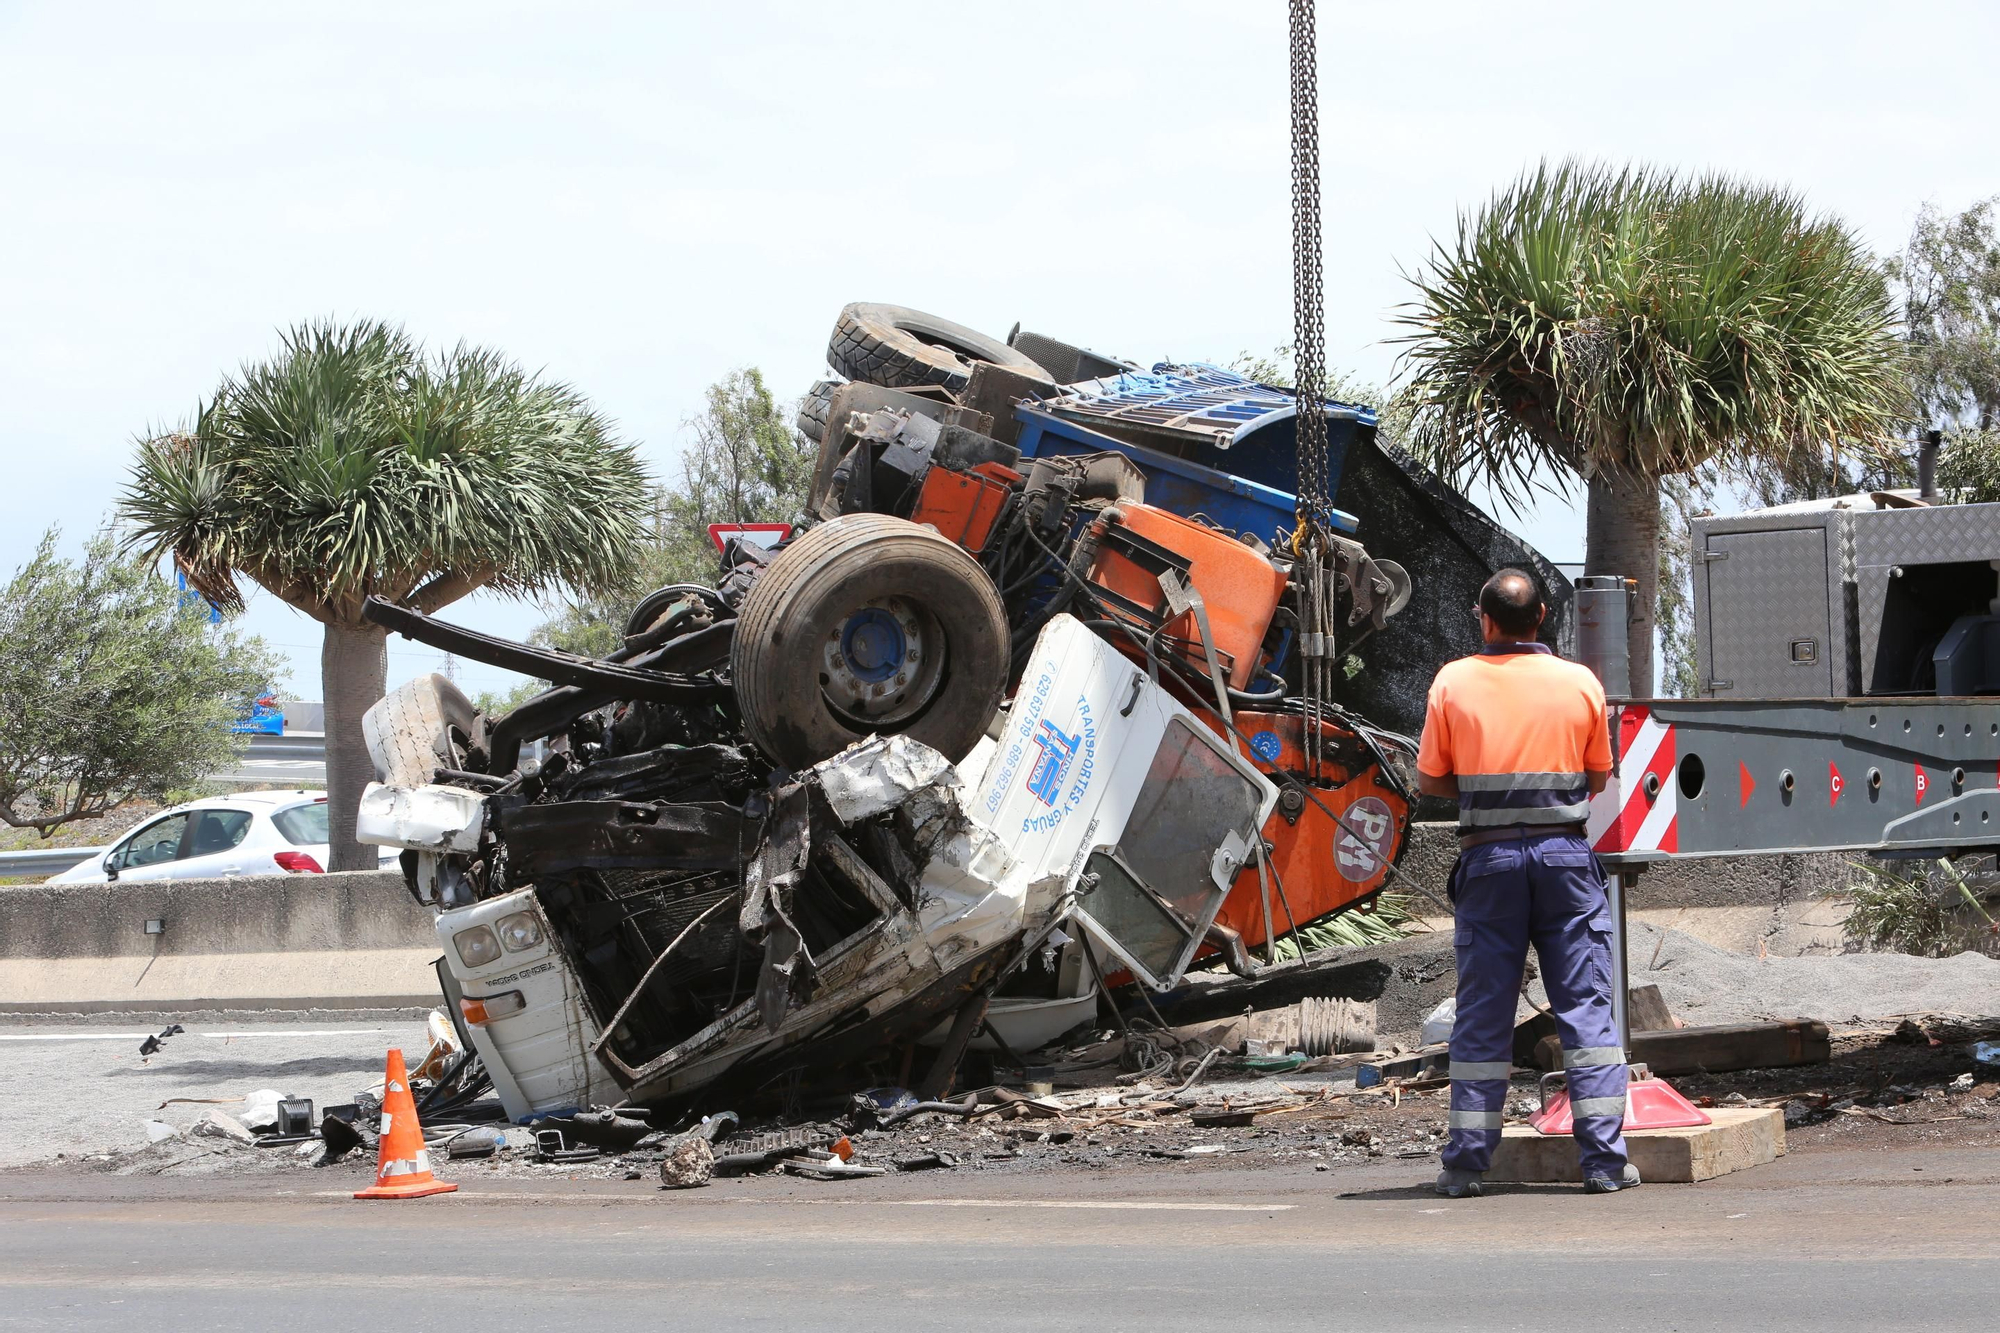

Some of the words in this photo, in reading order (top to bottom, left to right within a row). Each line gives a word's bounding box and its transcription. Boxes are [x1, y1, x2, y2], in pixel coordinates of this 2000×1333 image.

[1036, 674, 1052, 697] 629
[1028, 695, 1043, 719] 637
[1020, 716, 1035, 737] 519
[1006, 744, 1022, 768] 686
[1029, 729, 1058, 784] SANTANA
[1068, 694, 1095, 805] TRANSPORTES
[996, 766, 1012, 790] 962
[1052, 753, 1075, 792] HNOS.
[1831, 776, 1840, 792] C
[1917, 775, 1926, 790] B
[986, 788, 1002, 813] 967
[1064, 802, 1073, 816] Y
[1022, 809, 1063, 835] GRÚAS
[1080, 818, 1100, 852] TECNO
[1337, 805, 1389, 872] PM
[519, 962, 556, 979] TECNO
